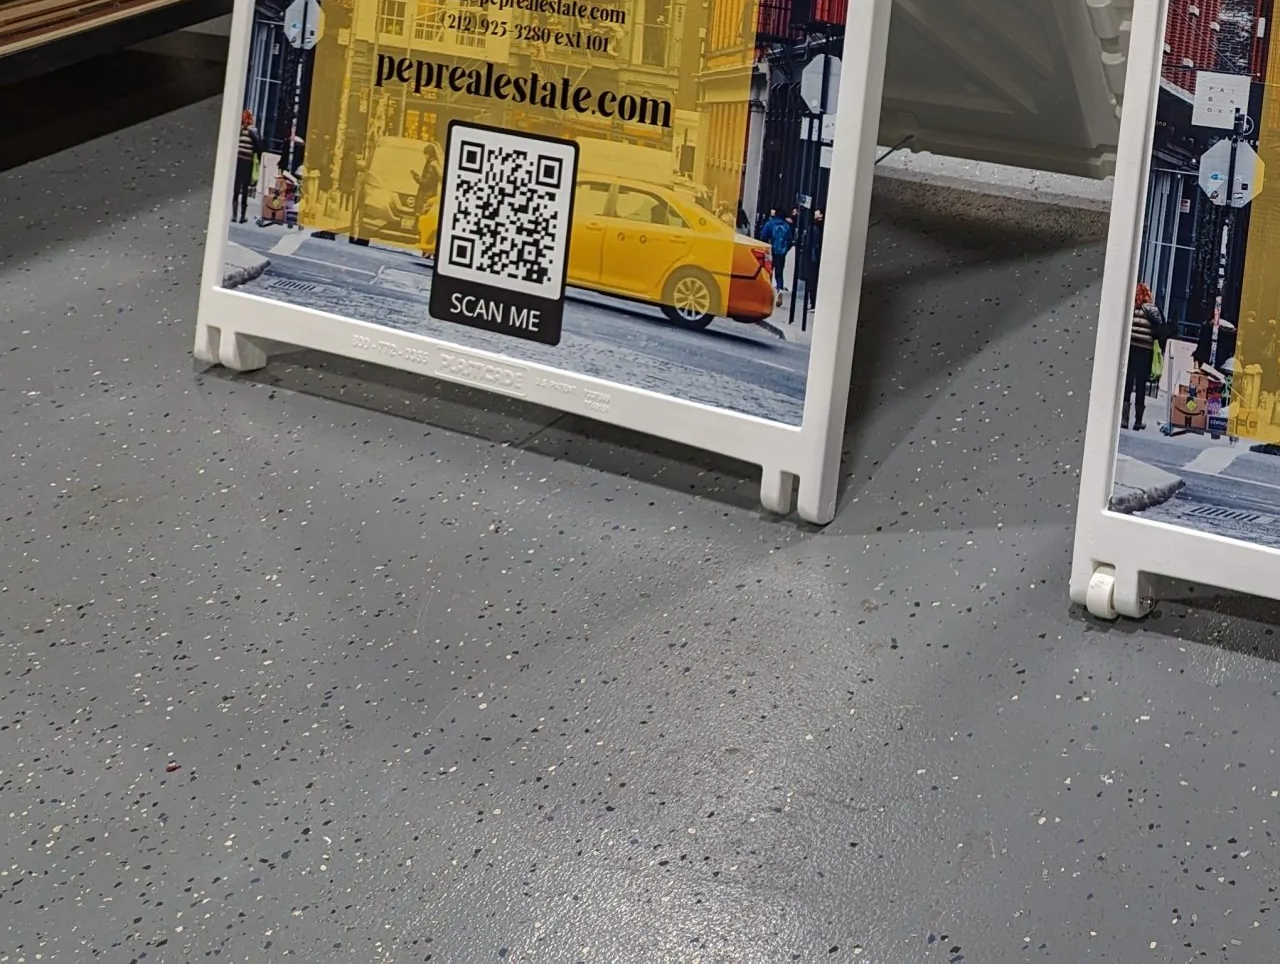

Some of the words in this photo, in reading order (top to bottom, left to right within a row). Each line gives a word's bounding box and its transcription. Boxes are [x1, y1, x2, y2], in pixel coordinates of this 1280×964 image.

[441, 10, 477, 32] (212)
[481, 18, 551, 45] 925-3280
[554, 31, 581, 49] ext
[586, 33, 609, 53] 101
[374, 52, 672, 129] peprealestate.com
[450, 292, 503, 323] SCAN
[508, 306, 541, 332] ME
